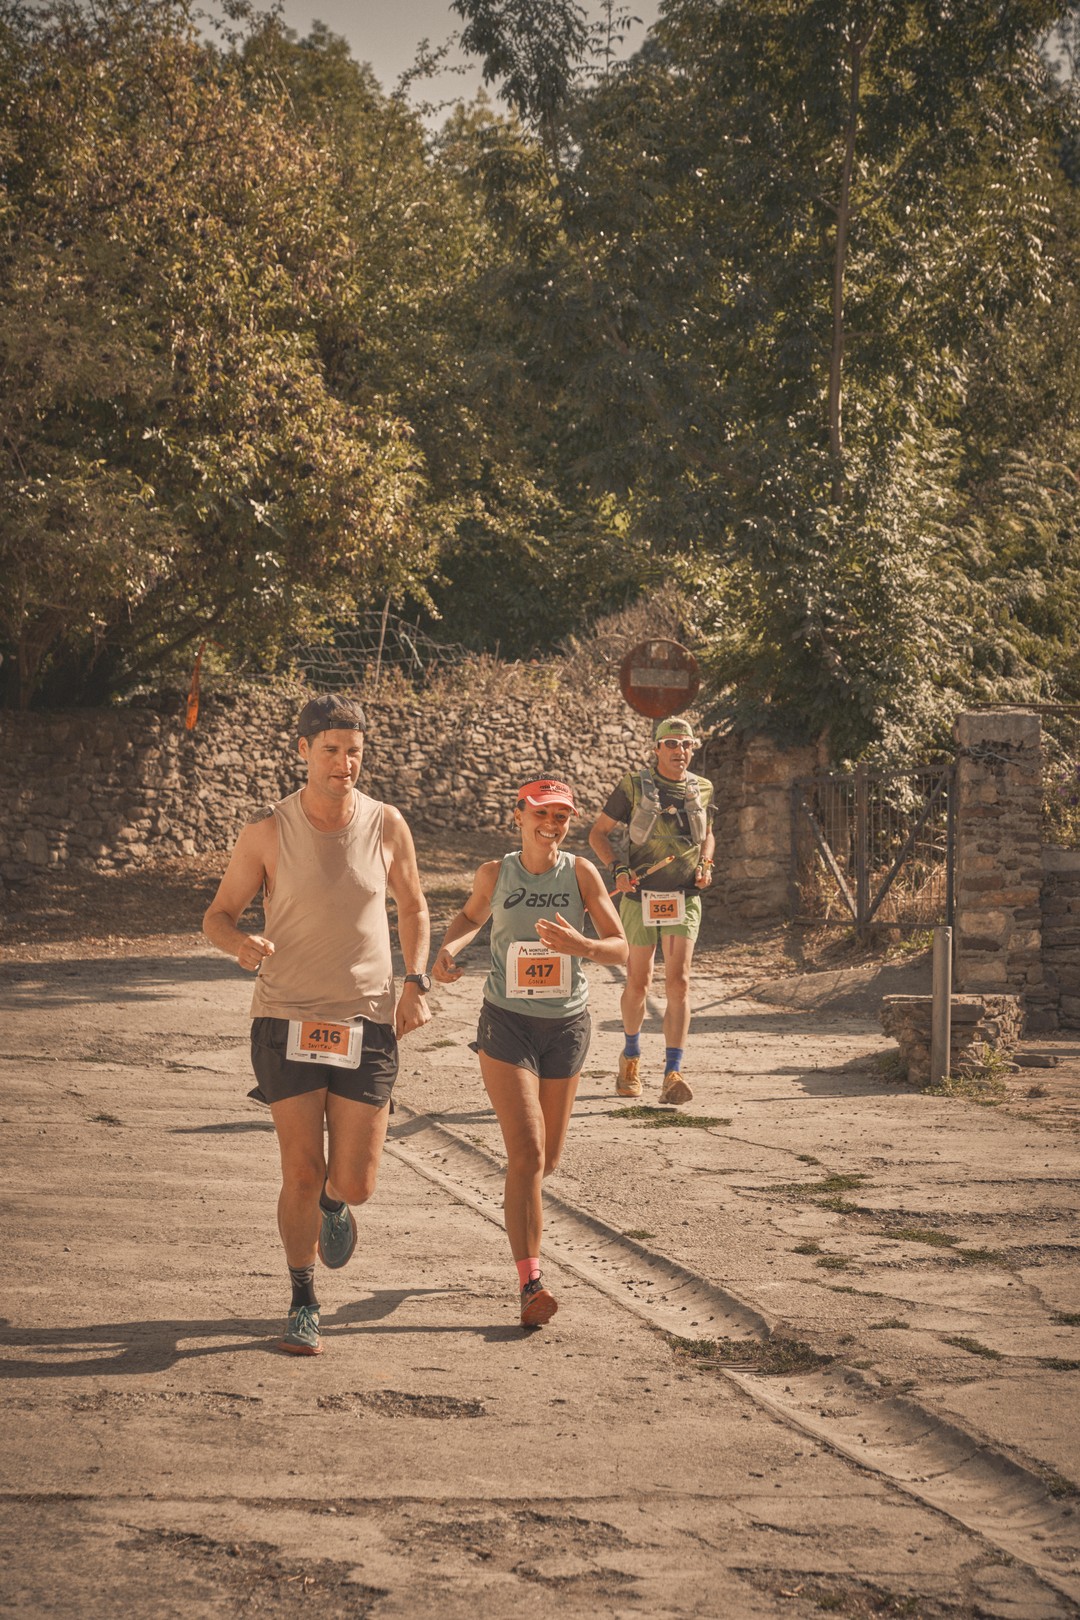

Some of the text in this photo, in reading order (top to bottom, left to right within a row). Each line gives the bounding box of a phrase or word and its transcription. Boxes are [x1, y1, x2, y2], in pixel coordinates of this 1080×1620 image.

[653, 904, 674, 913] 364
[525, 964, 554, 978] 417
[309, 1029, 341, 1044] 416
